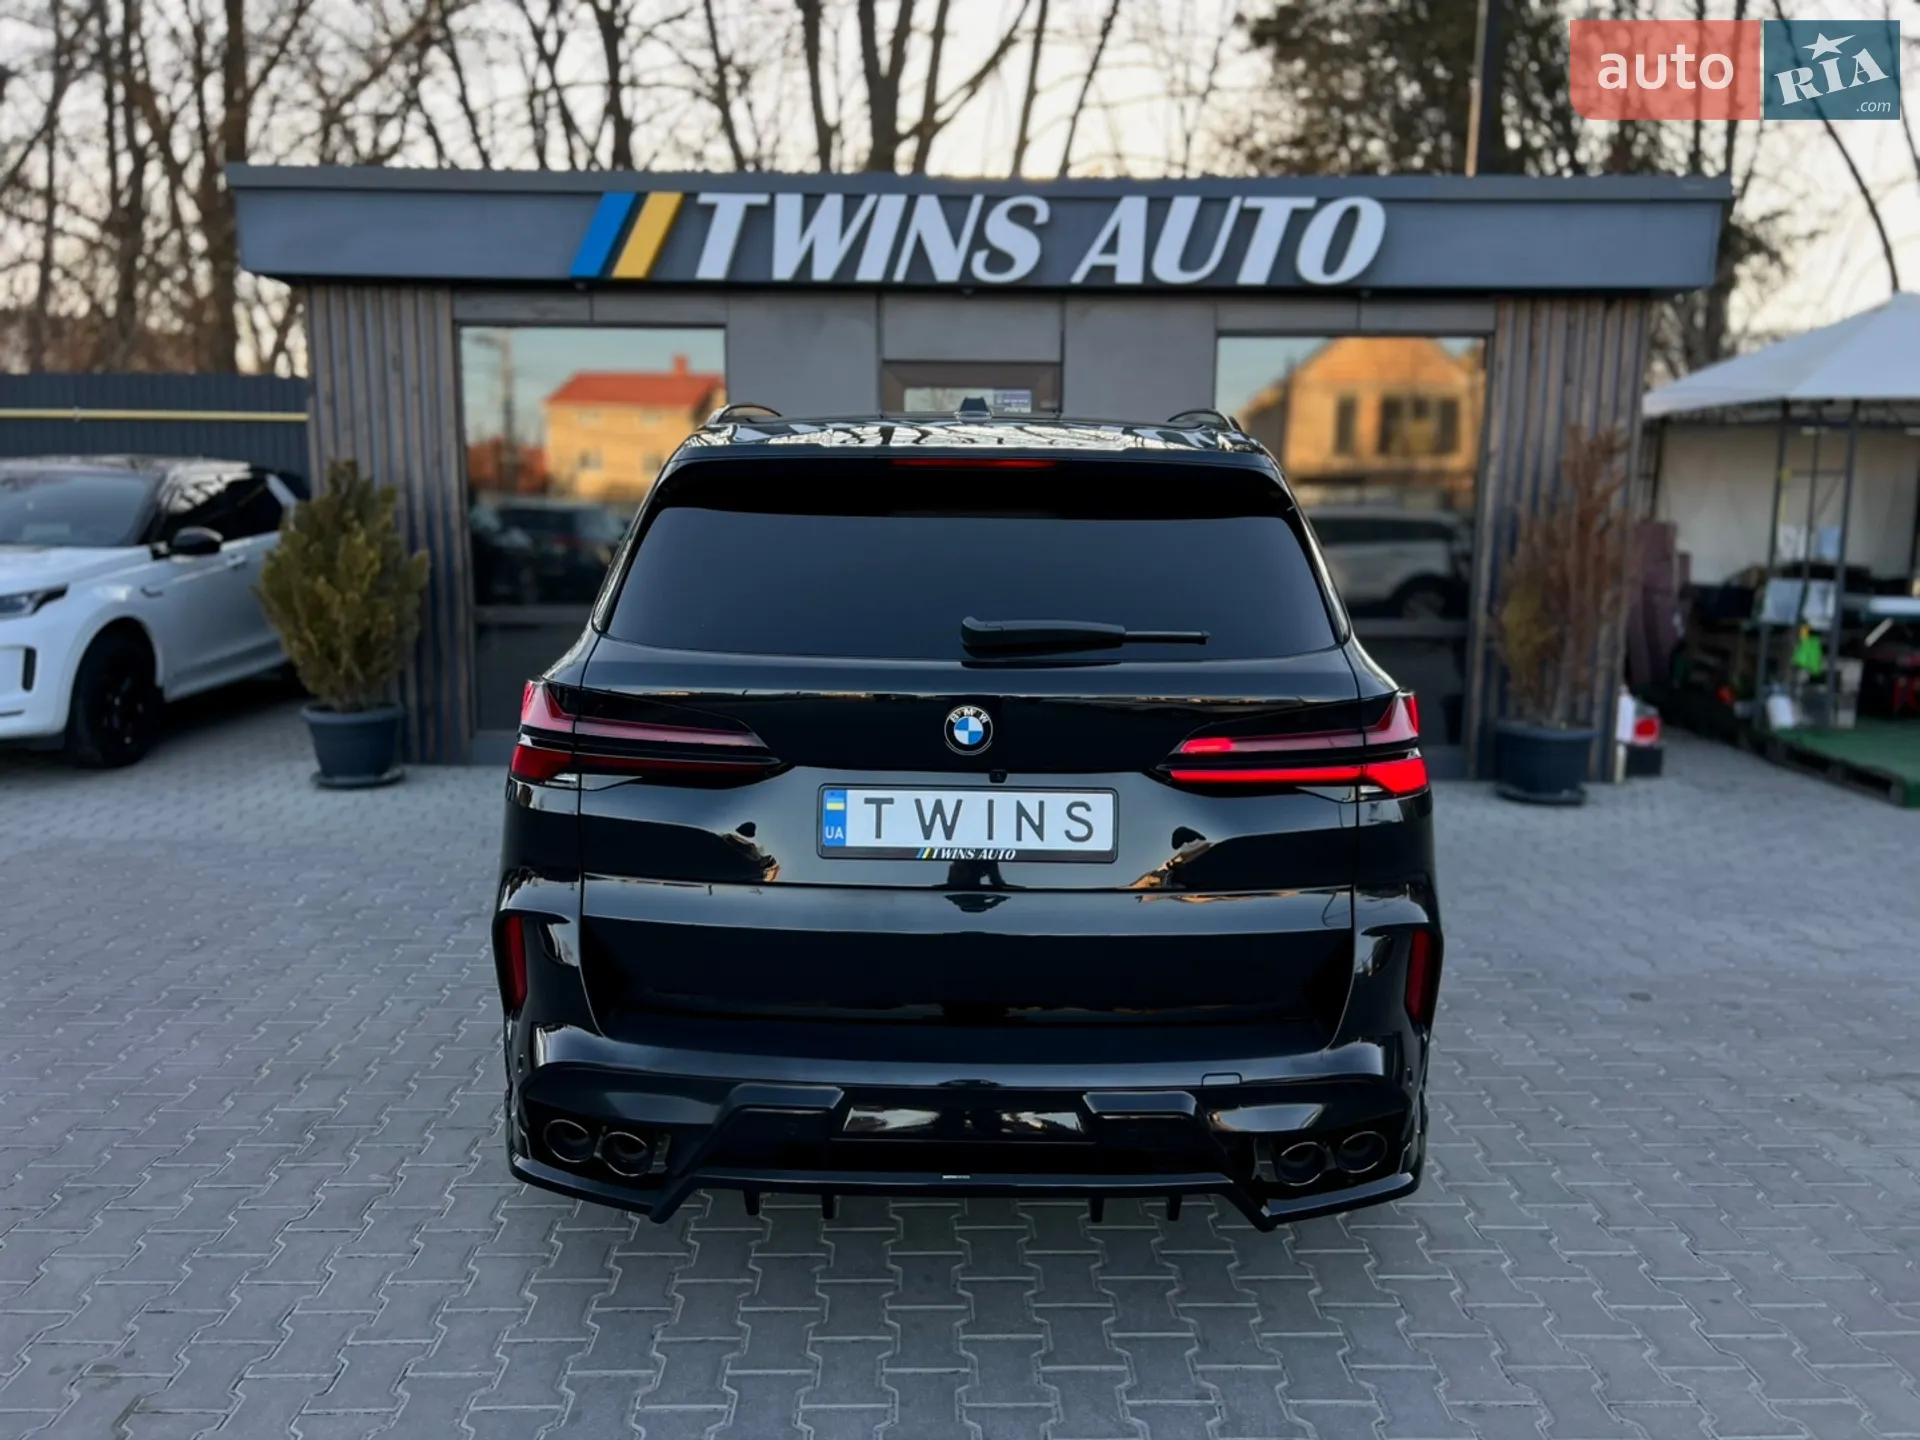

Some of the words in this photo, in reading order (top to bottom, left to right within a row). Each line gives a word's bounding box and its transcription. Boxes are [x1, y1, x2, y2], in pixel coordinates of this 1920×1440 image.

[695, 192, 1050, 284] TWINS
[1070, 195, 1387, 286] AUTO
[949, 708, 990, 724] BMW
[864, 798, 1094, 843] TWINS
[825, 826, 844, 839] UA
[931, 848, 975, 860] TWINS
[979, 848, 1016, 860] AUTO
